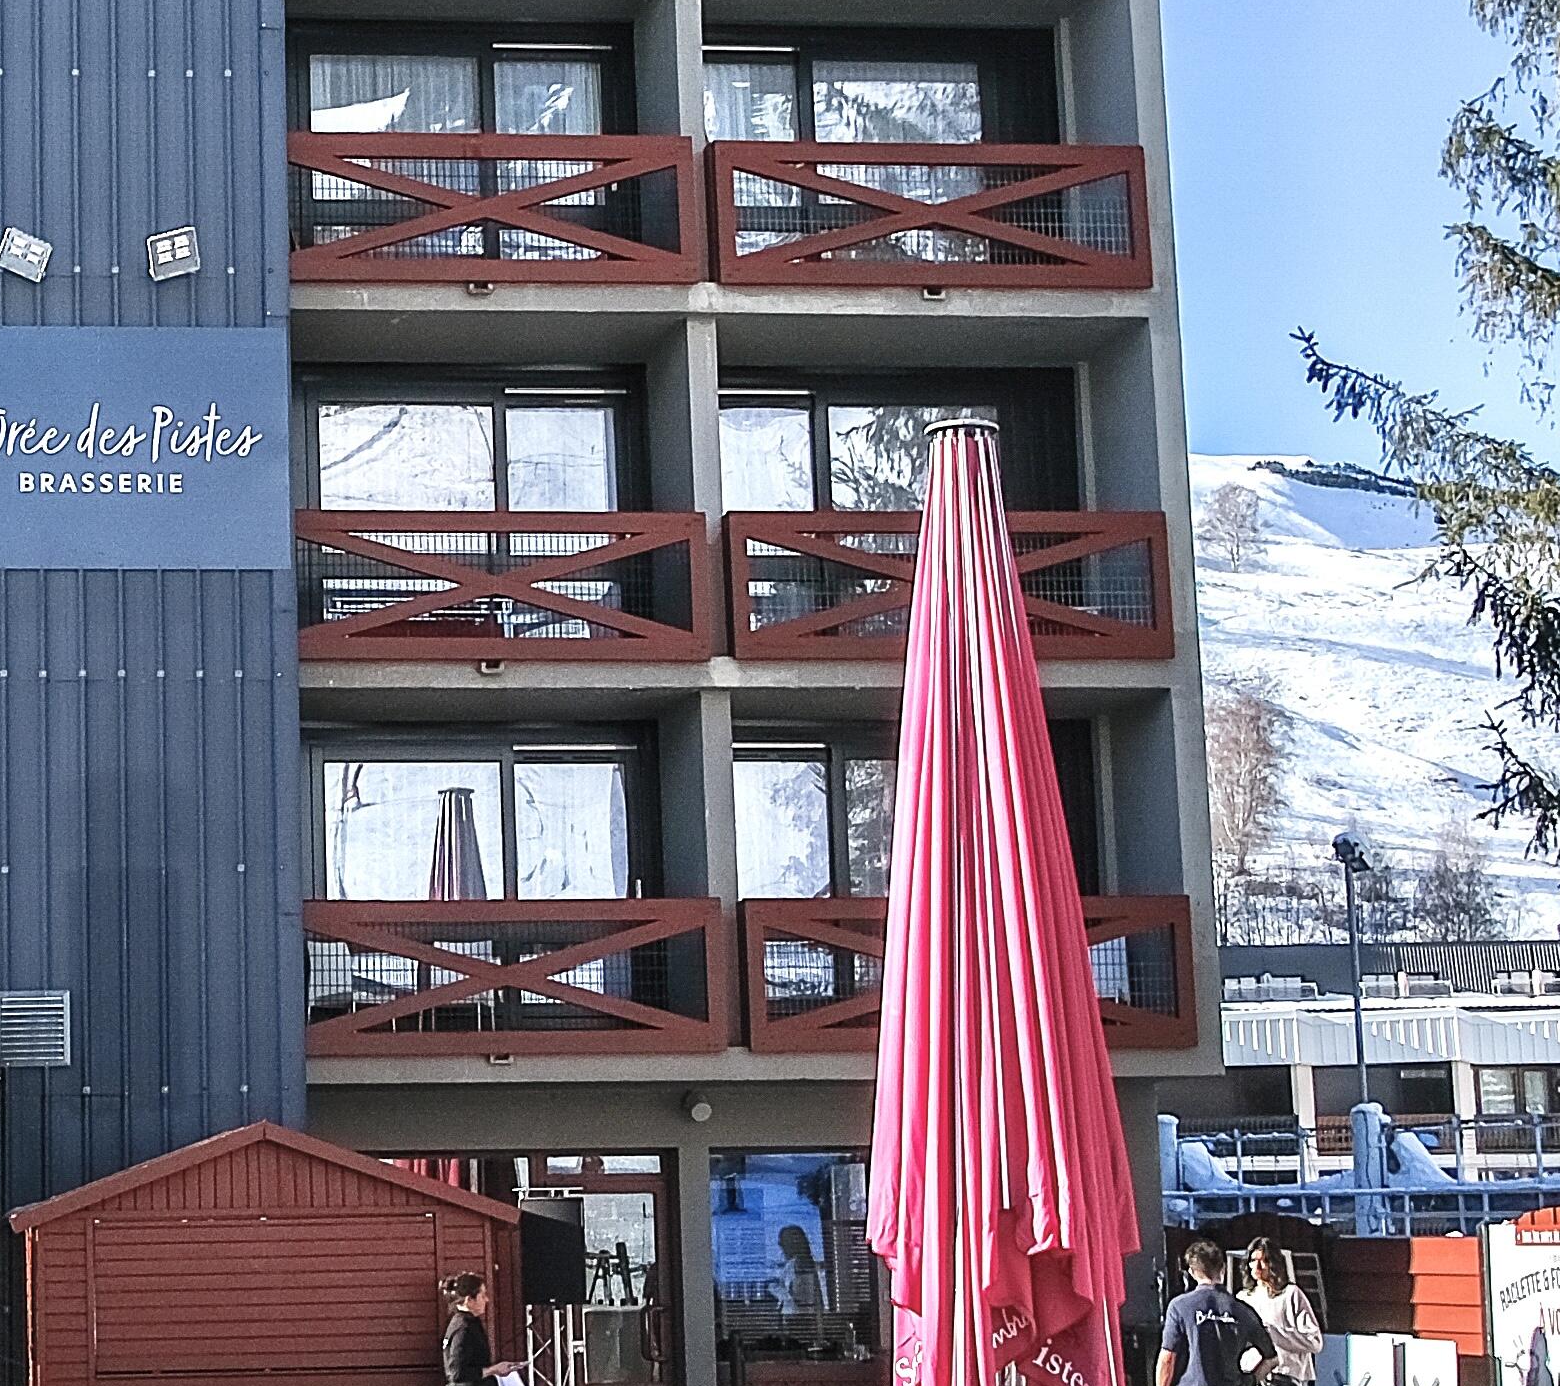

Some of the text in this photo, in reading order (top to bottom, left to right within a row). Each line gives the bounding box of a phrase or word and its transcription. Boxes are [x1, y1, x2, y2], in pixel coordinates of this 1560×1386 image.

[77, 402, 147, 460] des
[152, 402, 263, 463] Pistes
[18, 471, 184, 494] BRASSERIE
[1499, 1269, 1542, 1312] RACLETTE
